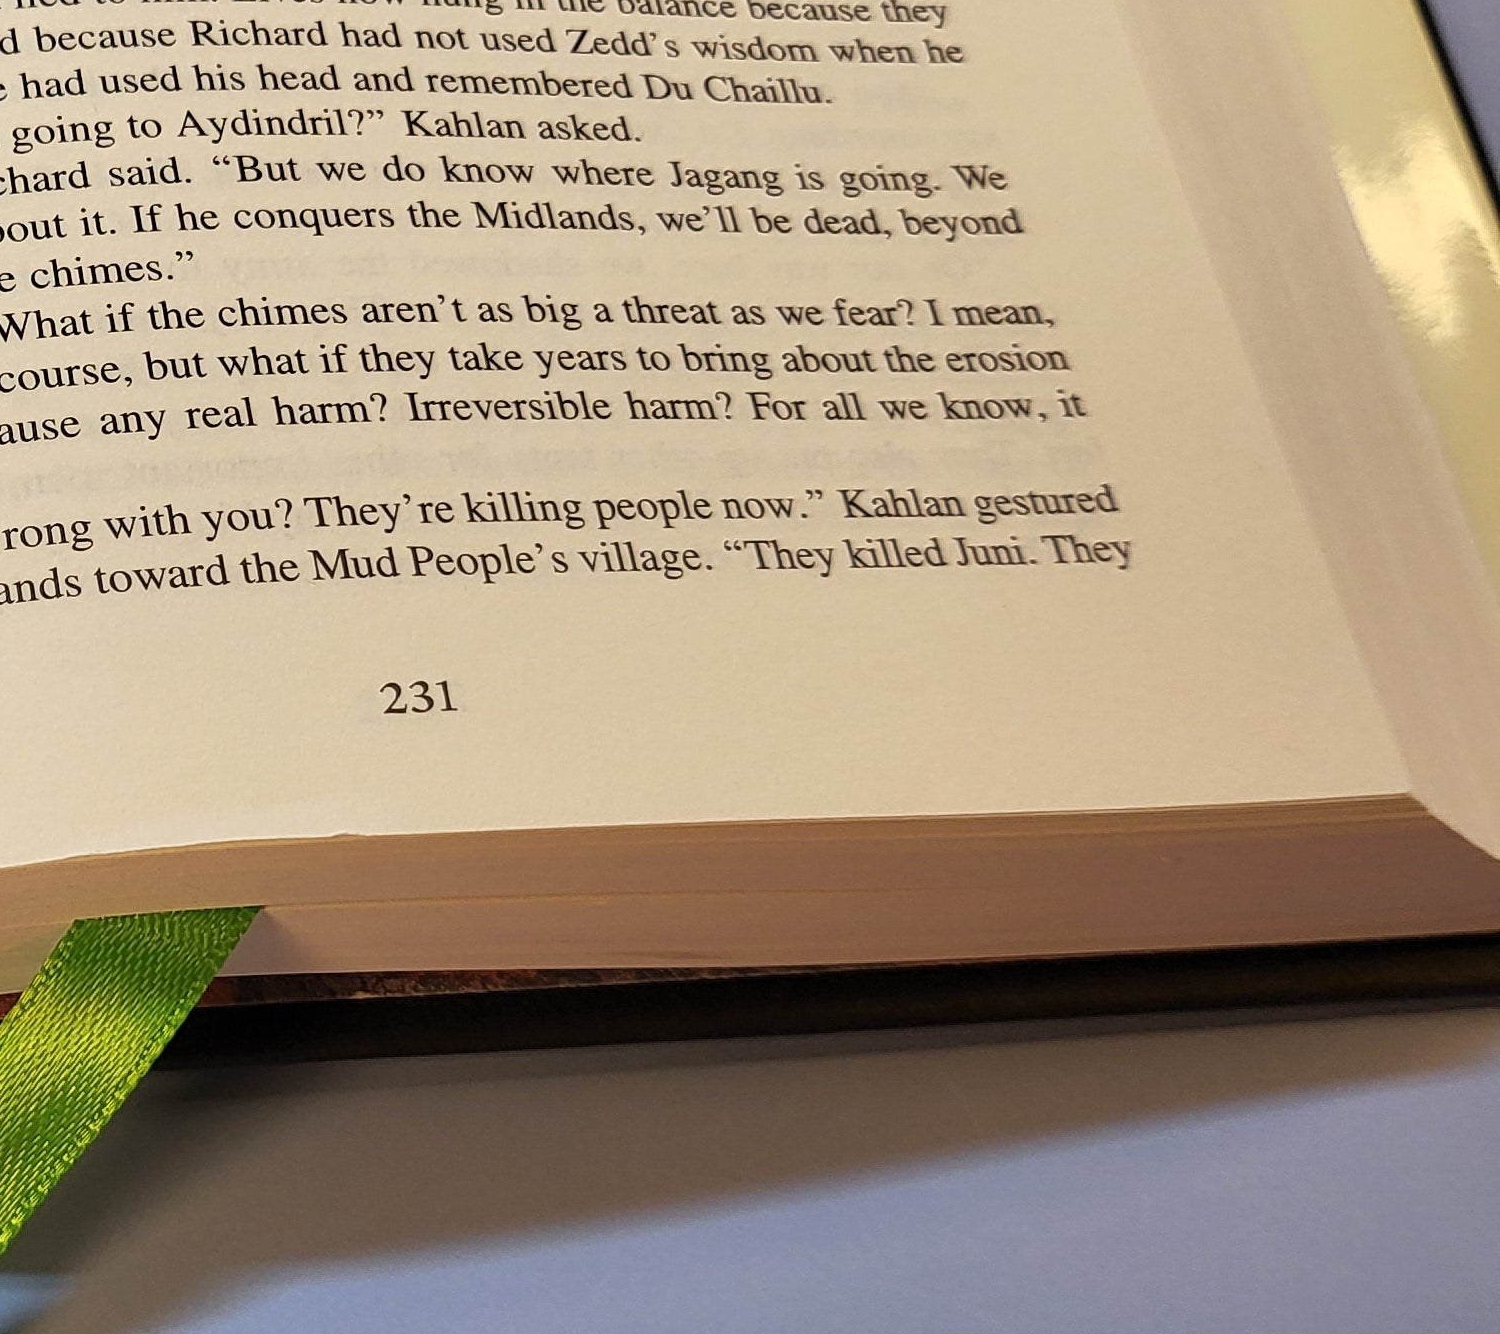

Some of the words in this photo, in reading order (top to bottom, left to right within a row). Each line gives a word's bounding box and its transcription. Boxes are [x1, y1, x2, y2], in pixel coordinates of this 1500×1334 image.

[12, 116, 115, 154] going
[127, 115, 162, 138] to
[177, 108, 383, 144] Aydindril?”
[401, 110, 526, 139] Kahlan
[538, 114, 641, 142] asked.
[31, 251, 193, 289] chimes.”
[103, 504, 192, 539] with
[201, 498, 292, 541] you?
[303, 494, 454, 533] They’re
[461, 491, 585, 530] killing
[592, 490, 713, 529] people
[720, 490, 823, 519] now.”
[836, 489, 967, 518] Kahlan
[974, 484, 1120, 524] gestured
[94, 554, 231, 594] toward
[239, 552, 300, 583] the
[308, 546, 400, 580] Mud
[406, 543, 569, 584] People’s
[577, 541, 713, 580] village.
[724, 540, 834, 577] “They
[842, 537, 948, 568] killed
[952, 536, 1038, 566] Juni.
[1040, 535, 1130, 570] They
[380, 681, 458, 714] 231
